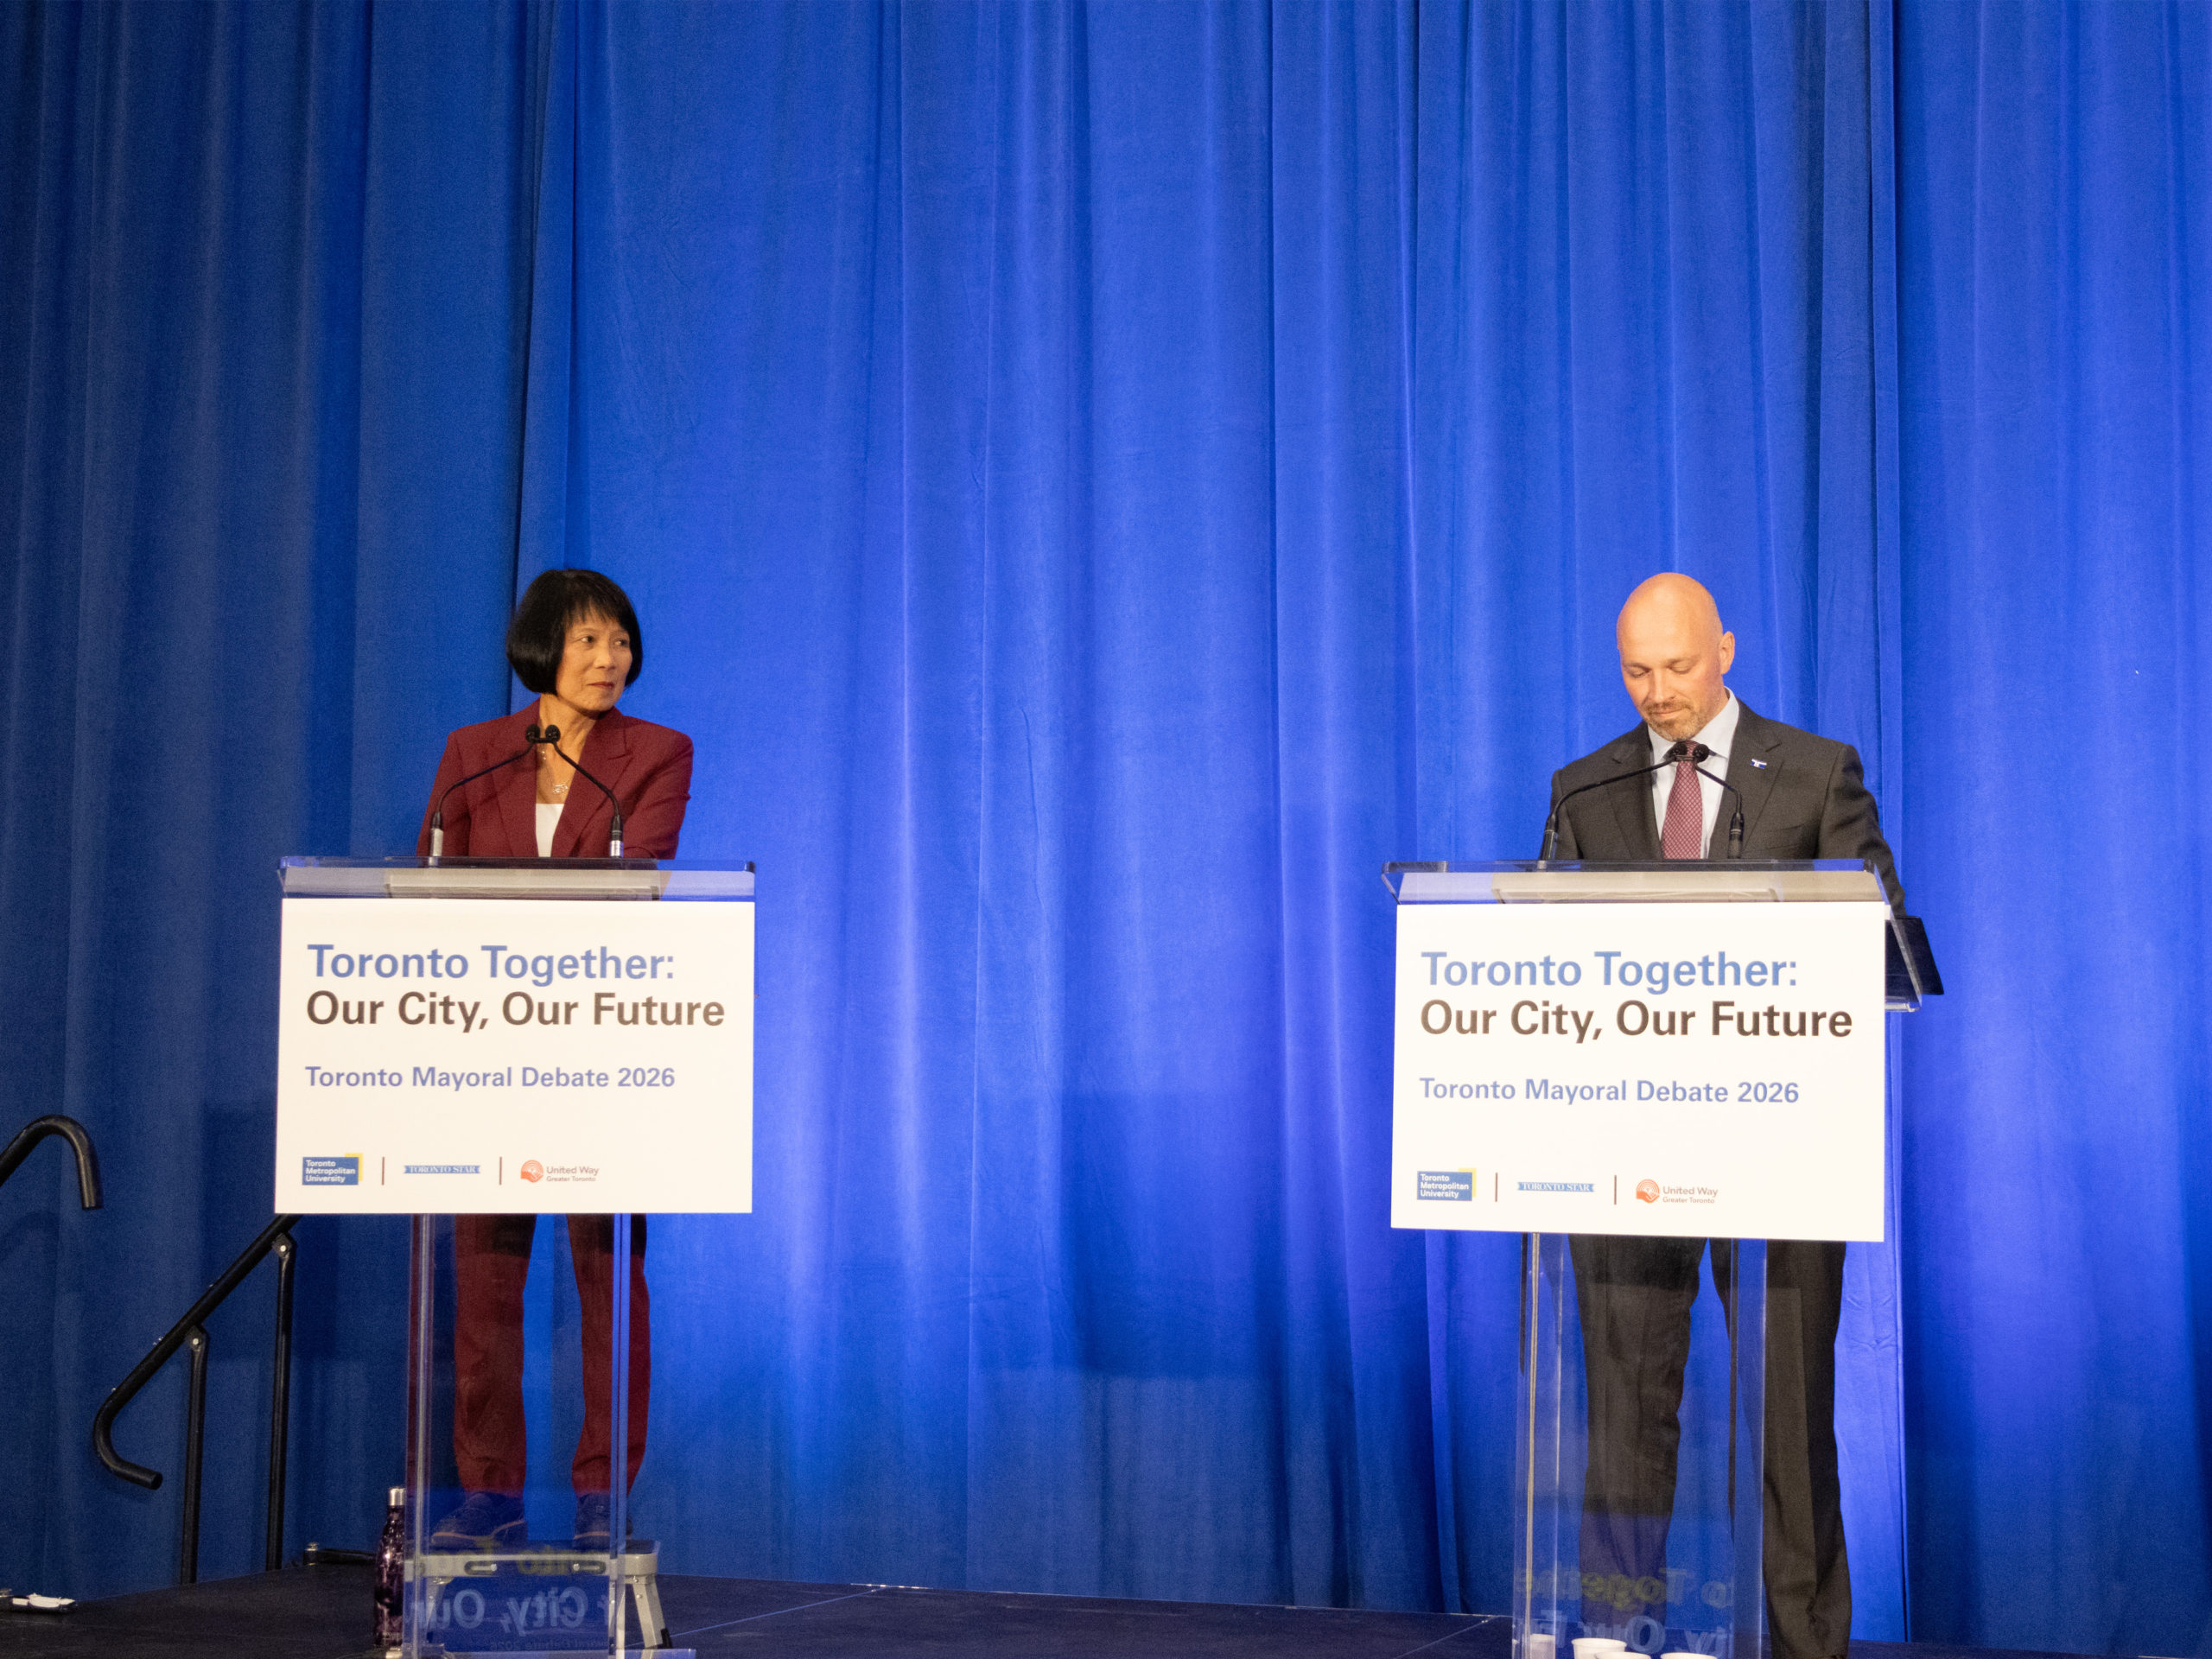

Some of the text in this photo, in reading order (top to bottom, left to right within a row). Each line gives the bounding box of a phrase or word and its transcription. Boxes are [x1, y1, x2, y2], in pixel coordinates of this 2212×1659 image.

[308, 944, 675, 987] Toronto Together:
[1421, 951, 1797, 995] Toronto Together:
[307, 990, 724, 1033] Our City, Our Future
[1421, 1000, 1853, 1044] Our City, Our Future
[305, 1066, 675, 1091] Toronto Mayoral Debate 2026
[1420, 1078, 1799, 1105] Toronto Mayoral Debate 2026
[546, 1166, 600, 1176] United Way
[306, 1175, 346, 1184] University
[1421, 1173, 1450, 1182] Toronto
[1421, 1181, 1470, 1191] Metropolitan
[1522, 1182, 1591, 1192] TORONTO STAR
[1662, 1186, 1719, 1197] United Way
[1421, 1190, 1459, 1199] University
